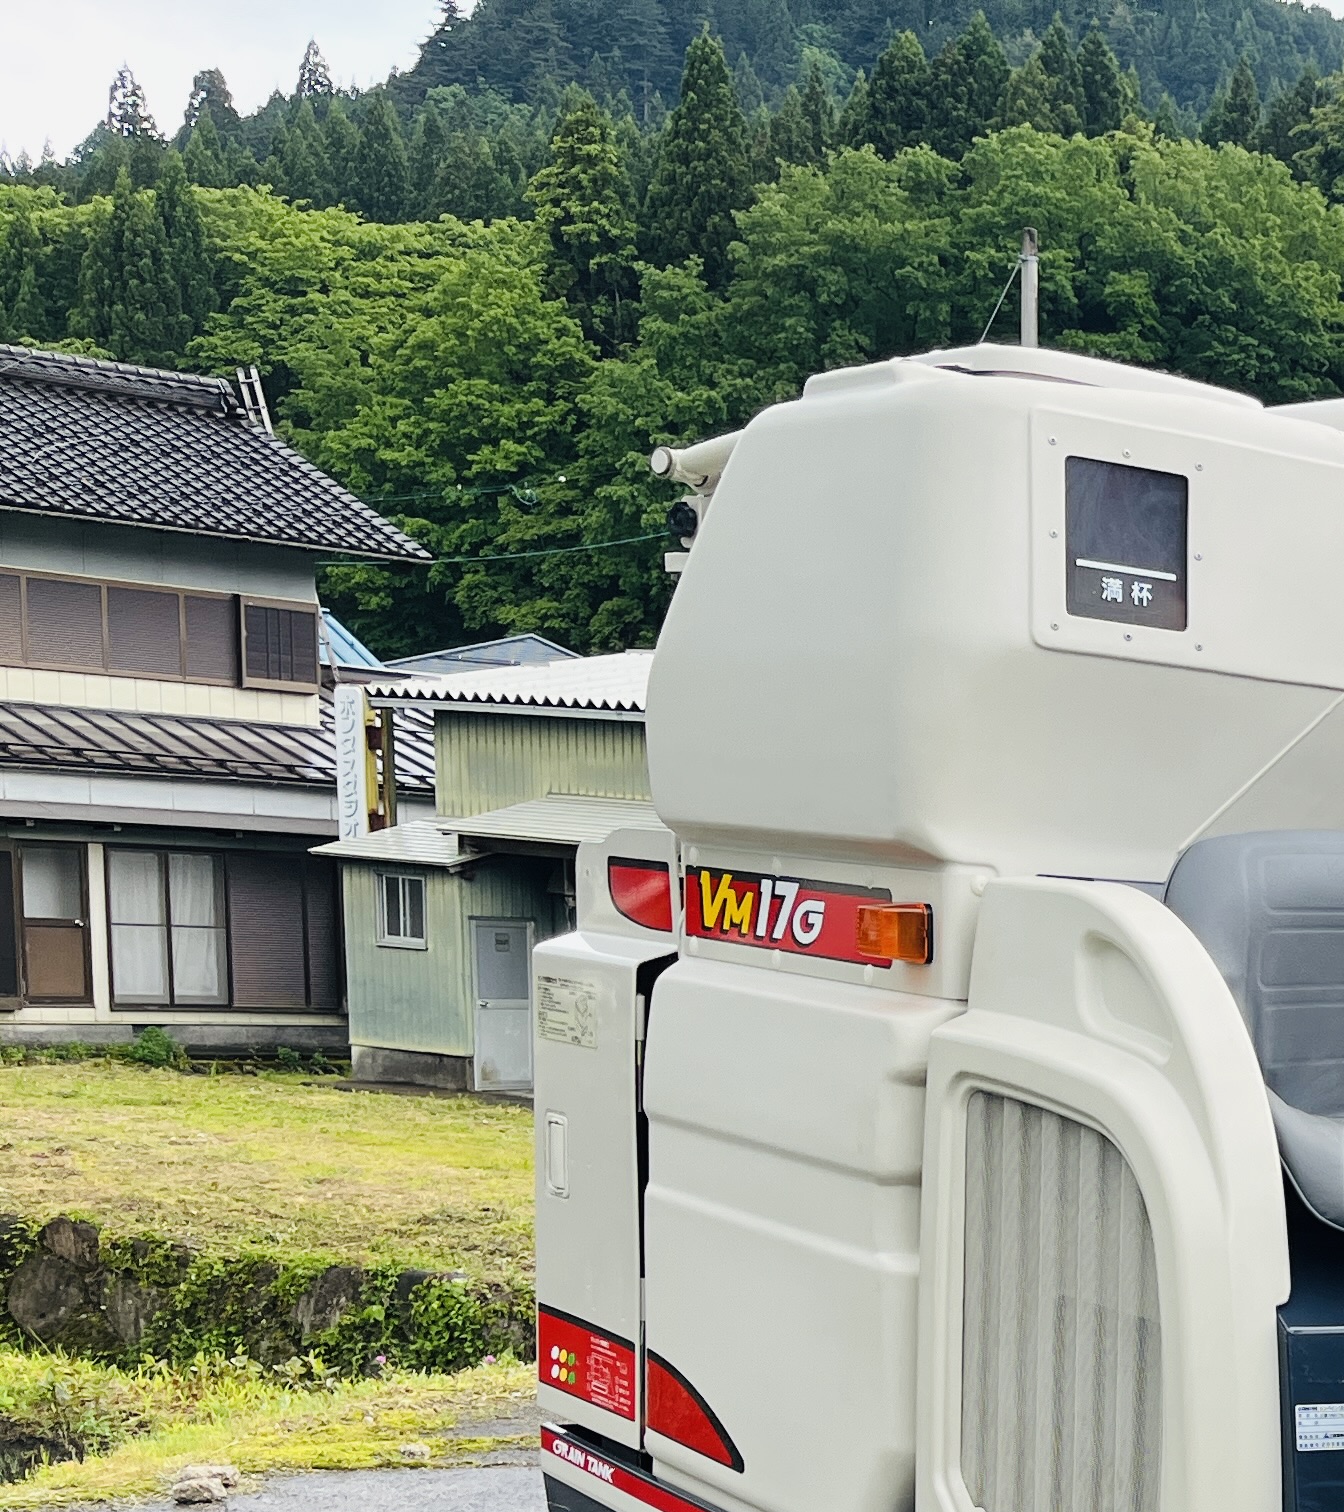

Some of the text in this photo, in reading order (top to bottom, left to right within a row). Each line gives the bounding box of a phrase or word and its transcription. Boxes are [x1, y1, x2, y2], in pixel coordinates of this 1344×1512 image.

[1101, 576, 1153, 607] 満杯
[552, 1439, 616, 1484] GRAIN TANK
